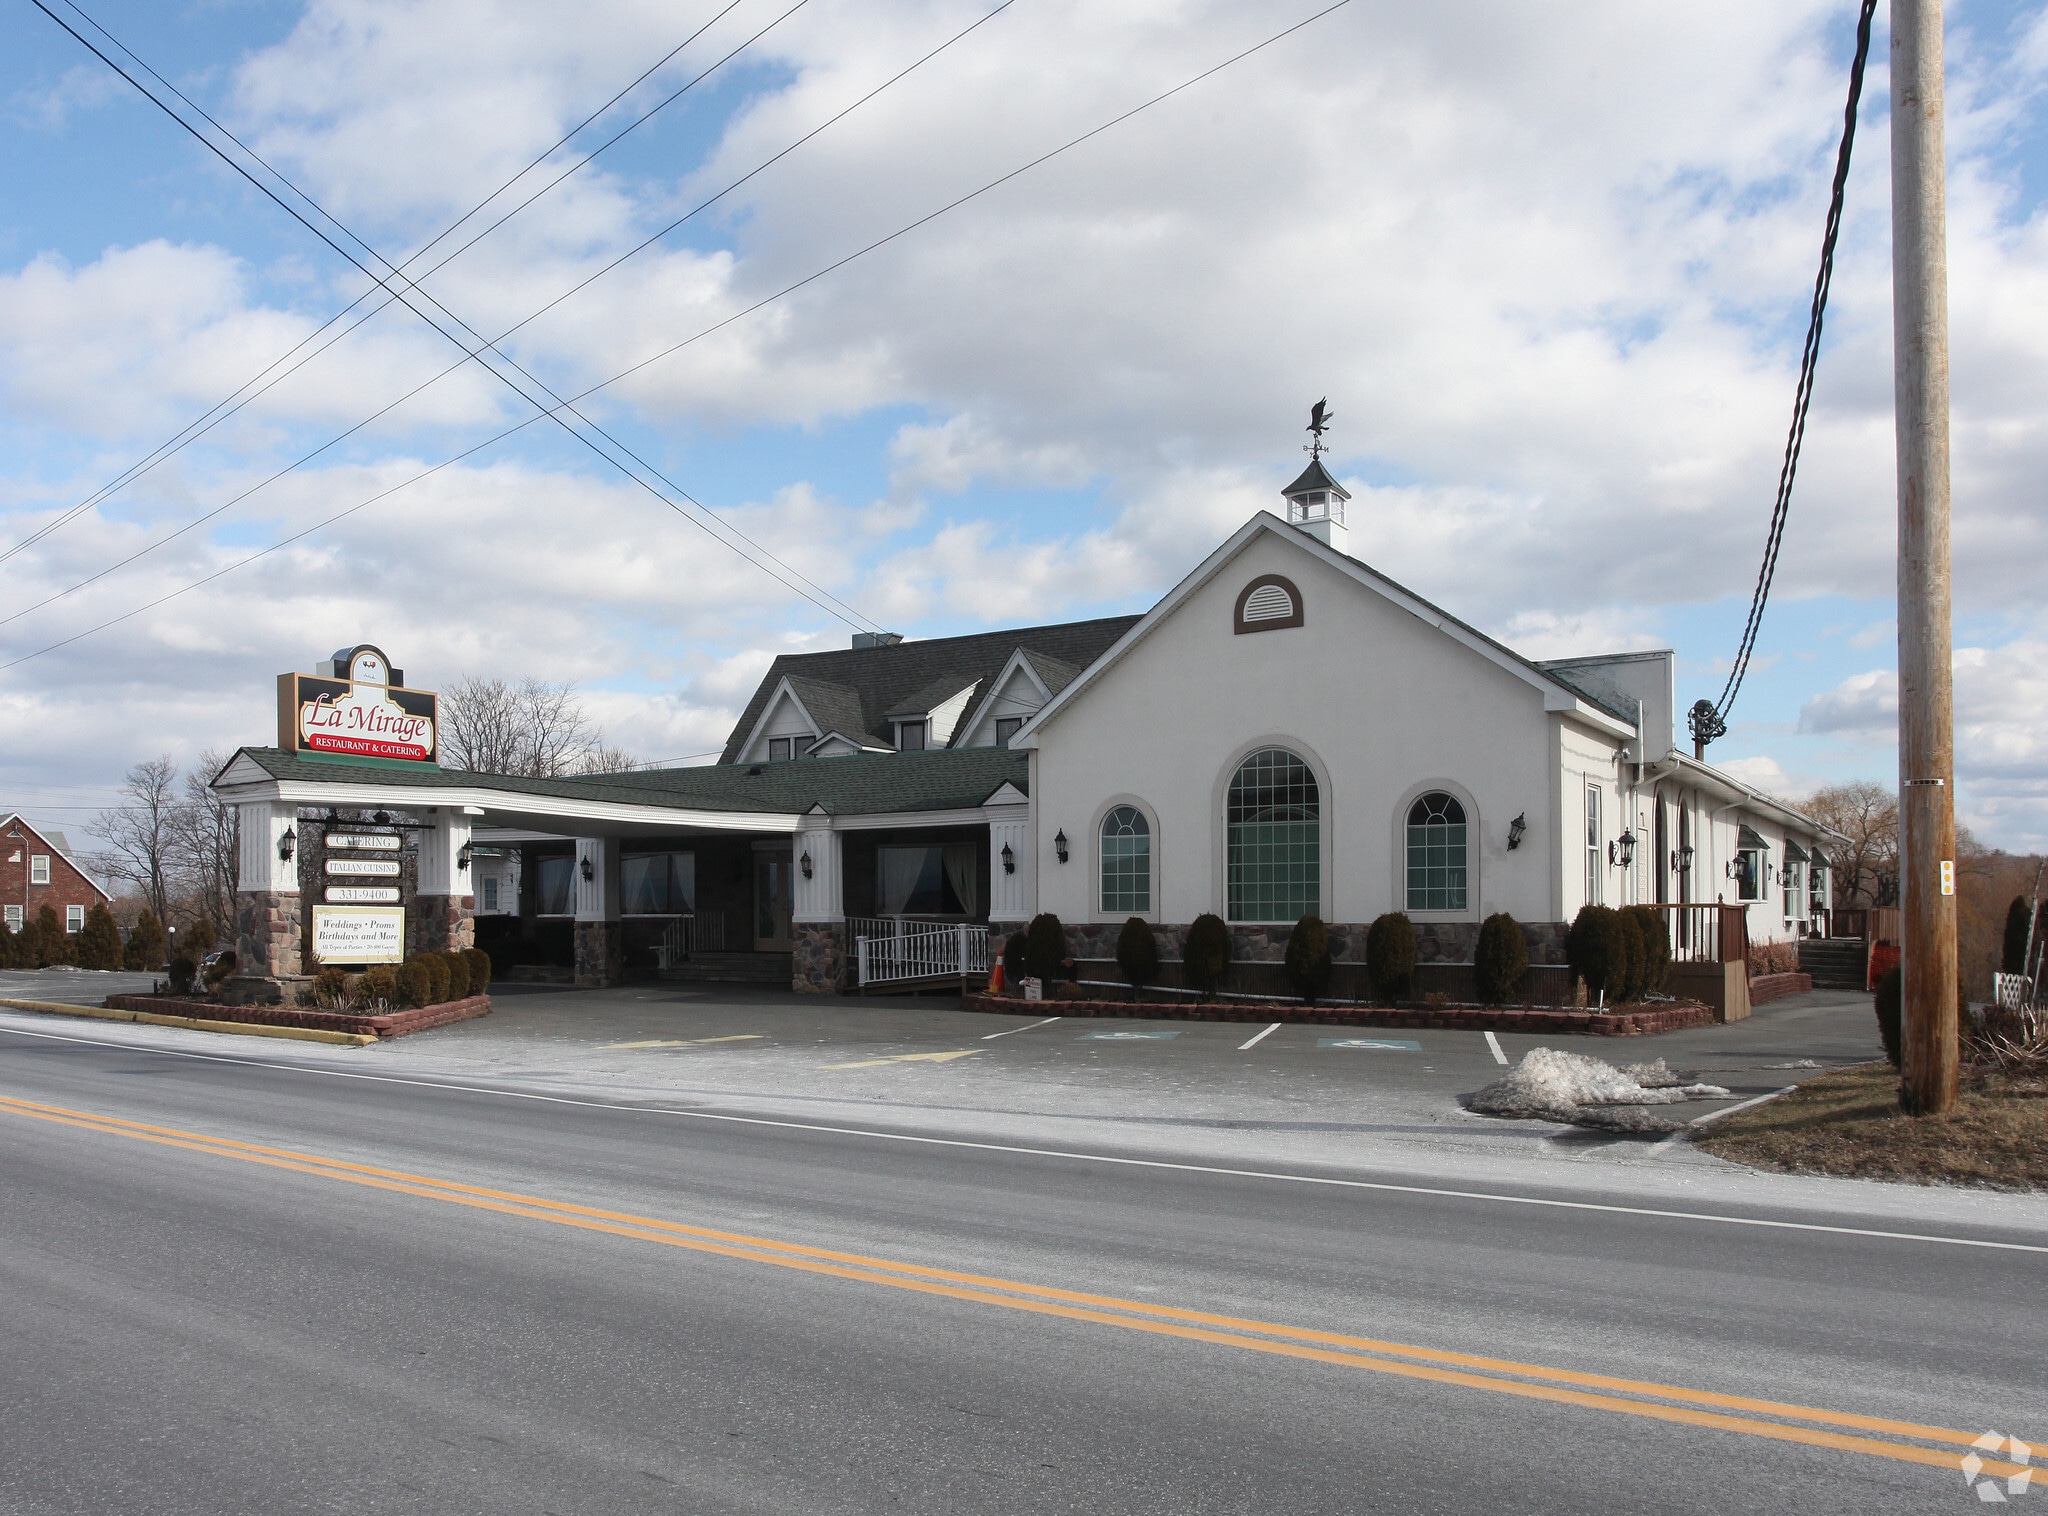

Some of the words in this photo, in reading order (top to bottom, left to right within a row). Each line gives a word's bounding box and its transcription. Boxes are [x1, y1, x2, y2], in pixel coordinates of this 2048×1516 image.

[306, 693, 343, 727] La
[347, 705, 426, 742] Mirage
[316, 737, 370, 752] RESTAURANT
[371, 744, 379, 752] &
[380, 744, 421, 757] CATERING
[336, 835, 391, 847] CATERING
[329, 862, 362, 872] ITALIAN
[363, 863, 397, 873] CUISINE
[339, 889, 388, 900] 331-9400
[323, 919, 362, 931] Weddings
[370, 920, 395, 929] Proms
[319, 931, 359, 943] Birthdays
[361, 932, 377, 941] and
[379, 932, 398, 941] More
